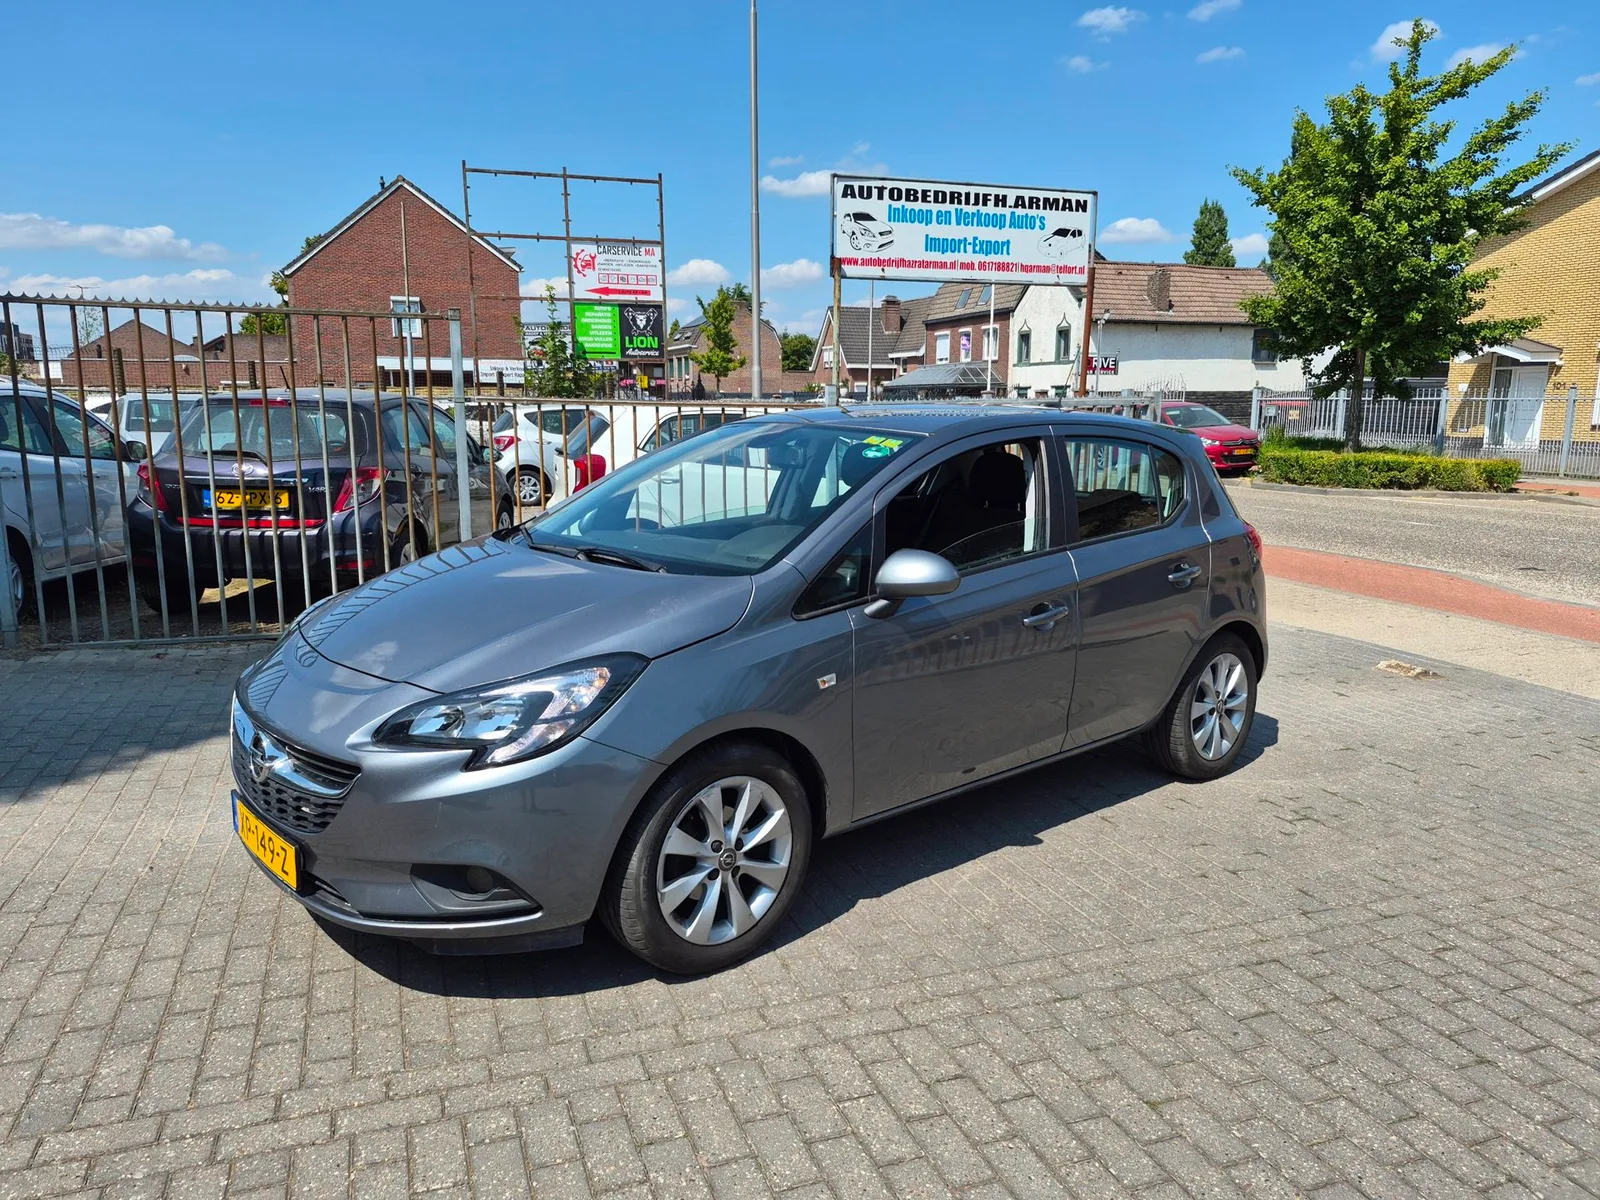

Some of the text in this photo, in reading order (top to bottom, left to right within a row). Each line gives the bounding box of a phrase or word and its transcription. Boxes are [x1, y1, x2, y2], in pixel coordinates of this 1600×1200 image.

[887, 204, 1046, 230] Inkoop en Verkoop Auto's
[924, 233, 1011, 256] Import-Export
[597, 245, 656, 257] CARSERVICE MA
[959, 262, 977, 271] mob.
[978, 260, 1017, 272] 0617188821
[625, 336, 659, 348] LION
